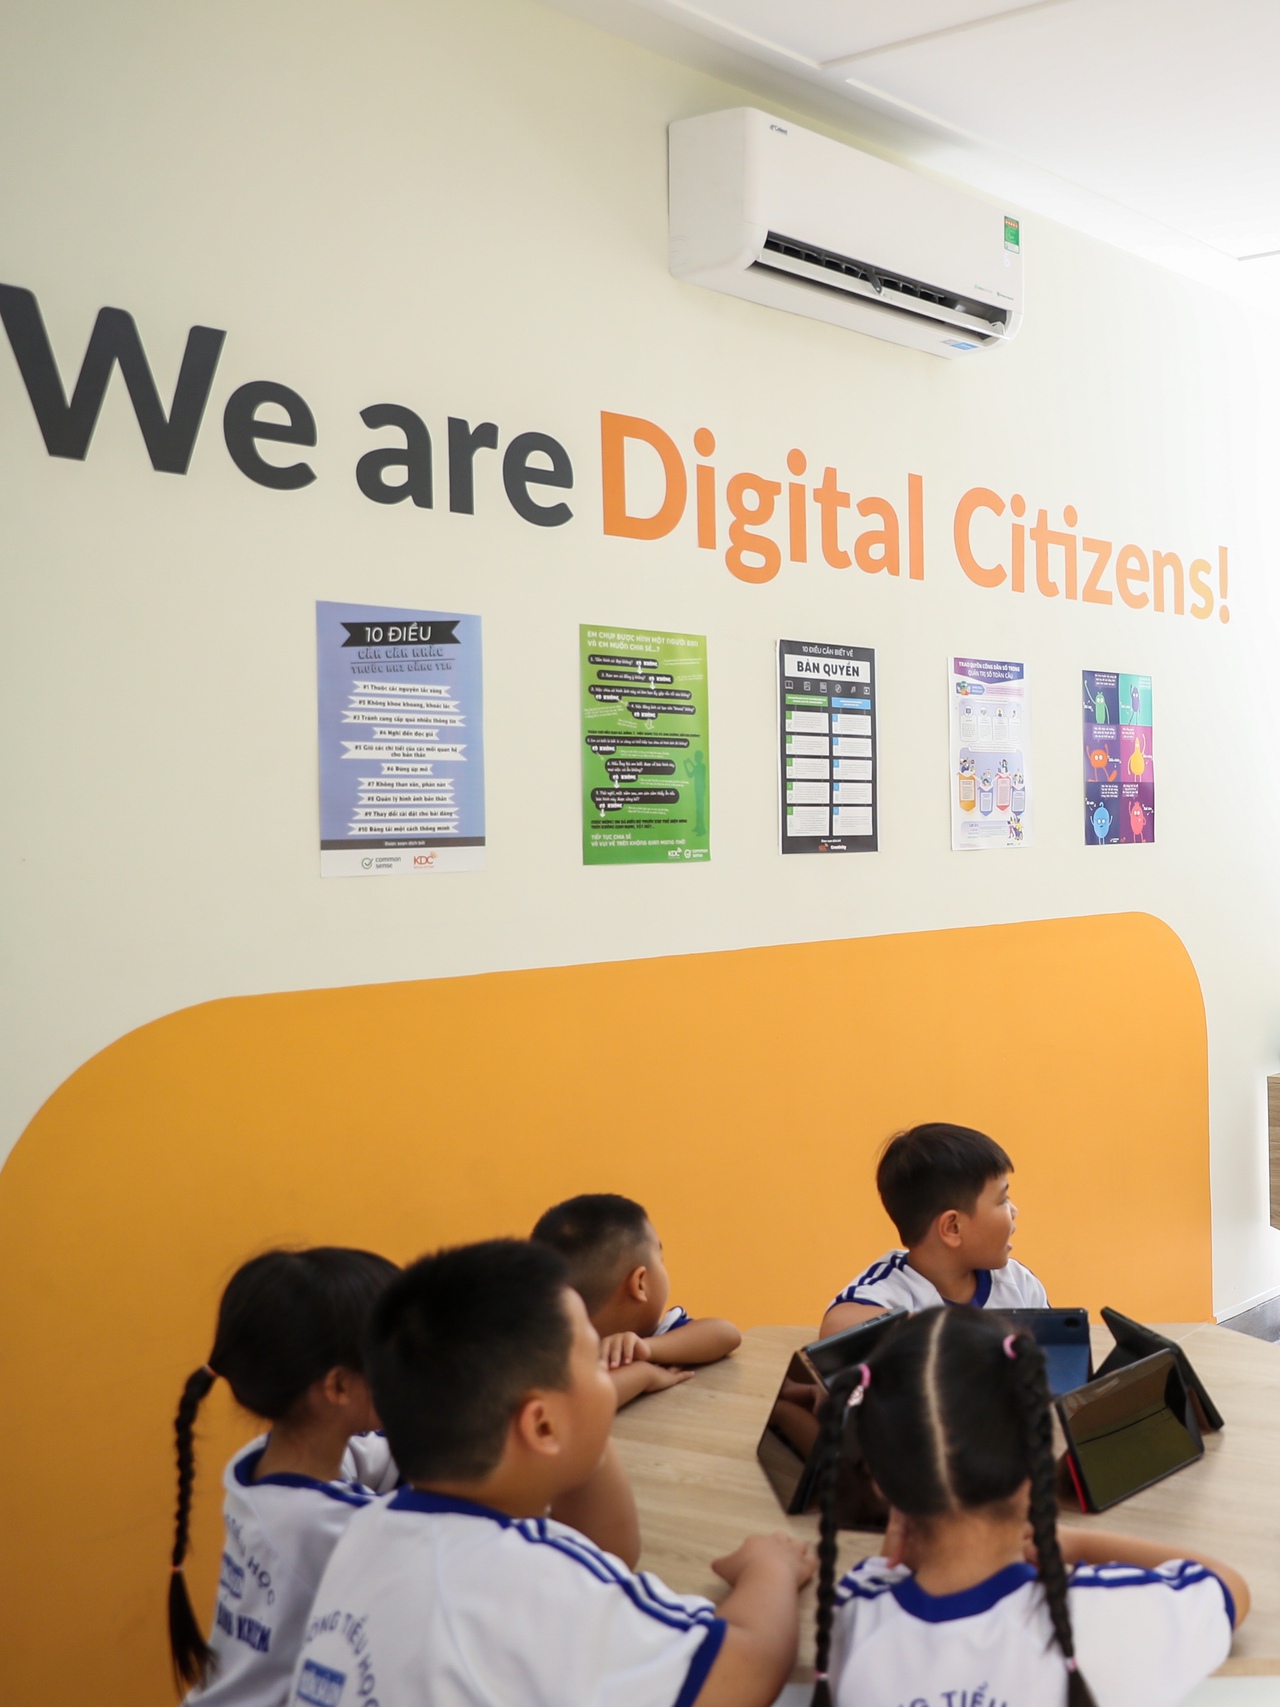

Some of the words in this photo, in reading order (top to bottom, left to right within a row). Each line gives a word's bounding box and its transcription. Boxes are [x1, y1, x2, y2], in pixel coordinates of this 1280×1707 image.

[0, 282, 317, 491] We
[356, 403, 573, 527] are
[601, 410, 924, 584] Digital
[954, 486, 1229, 624] Citizens!
[365, 626, 383, 643] 10
[388, 622, 432, 642] ĐIỀU
[797, 659, 820, 673] BẢN
[414, 855, 435, 865] KDC
